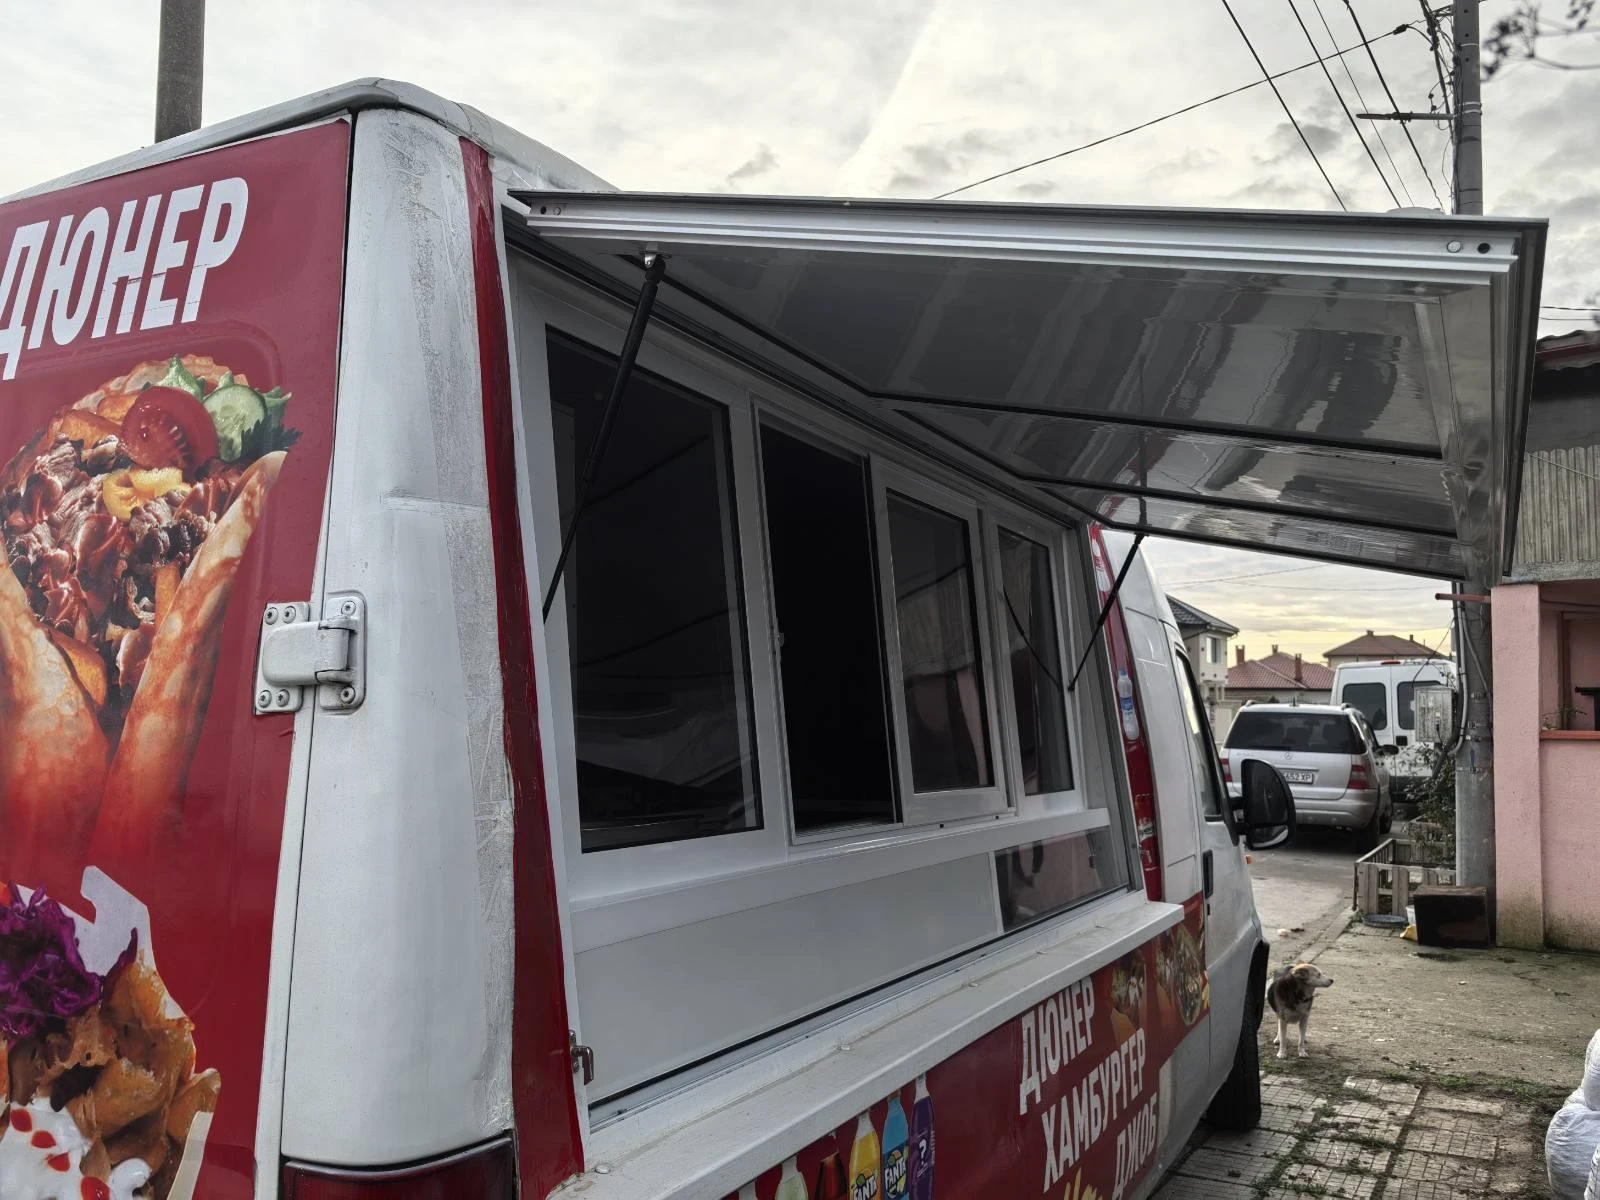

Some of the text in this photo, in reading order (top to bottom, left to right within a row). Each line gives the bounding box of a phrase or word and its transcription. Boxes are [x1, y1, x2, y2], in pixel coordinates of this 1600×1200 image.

[0, 177, 249, 380] ДЮНЕР
[1019, 976, 1096, 1116] ДЮНЕР
[1041, 1027, 1147, 1194] ХАМБУРГЕР
[884, 1157, 907, 1193] FANTA
